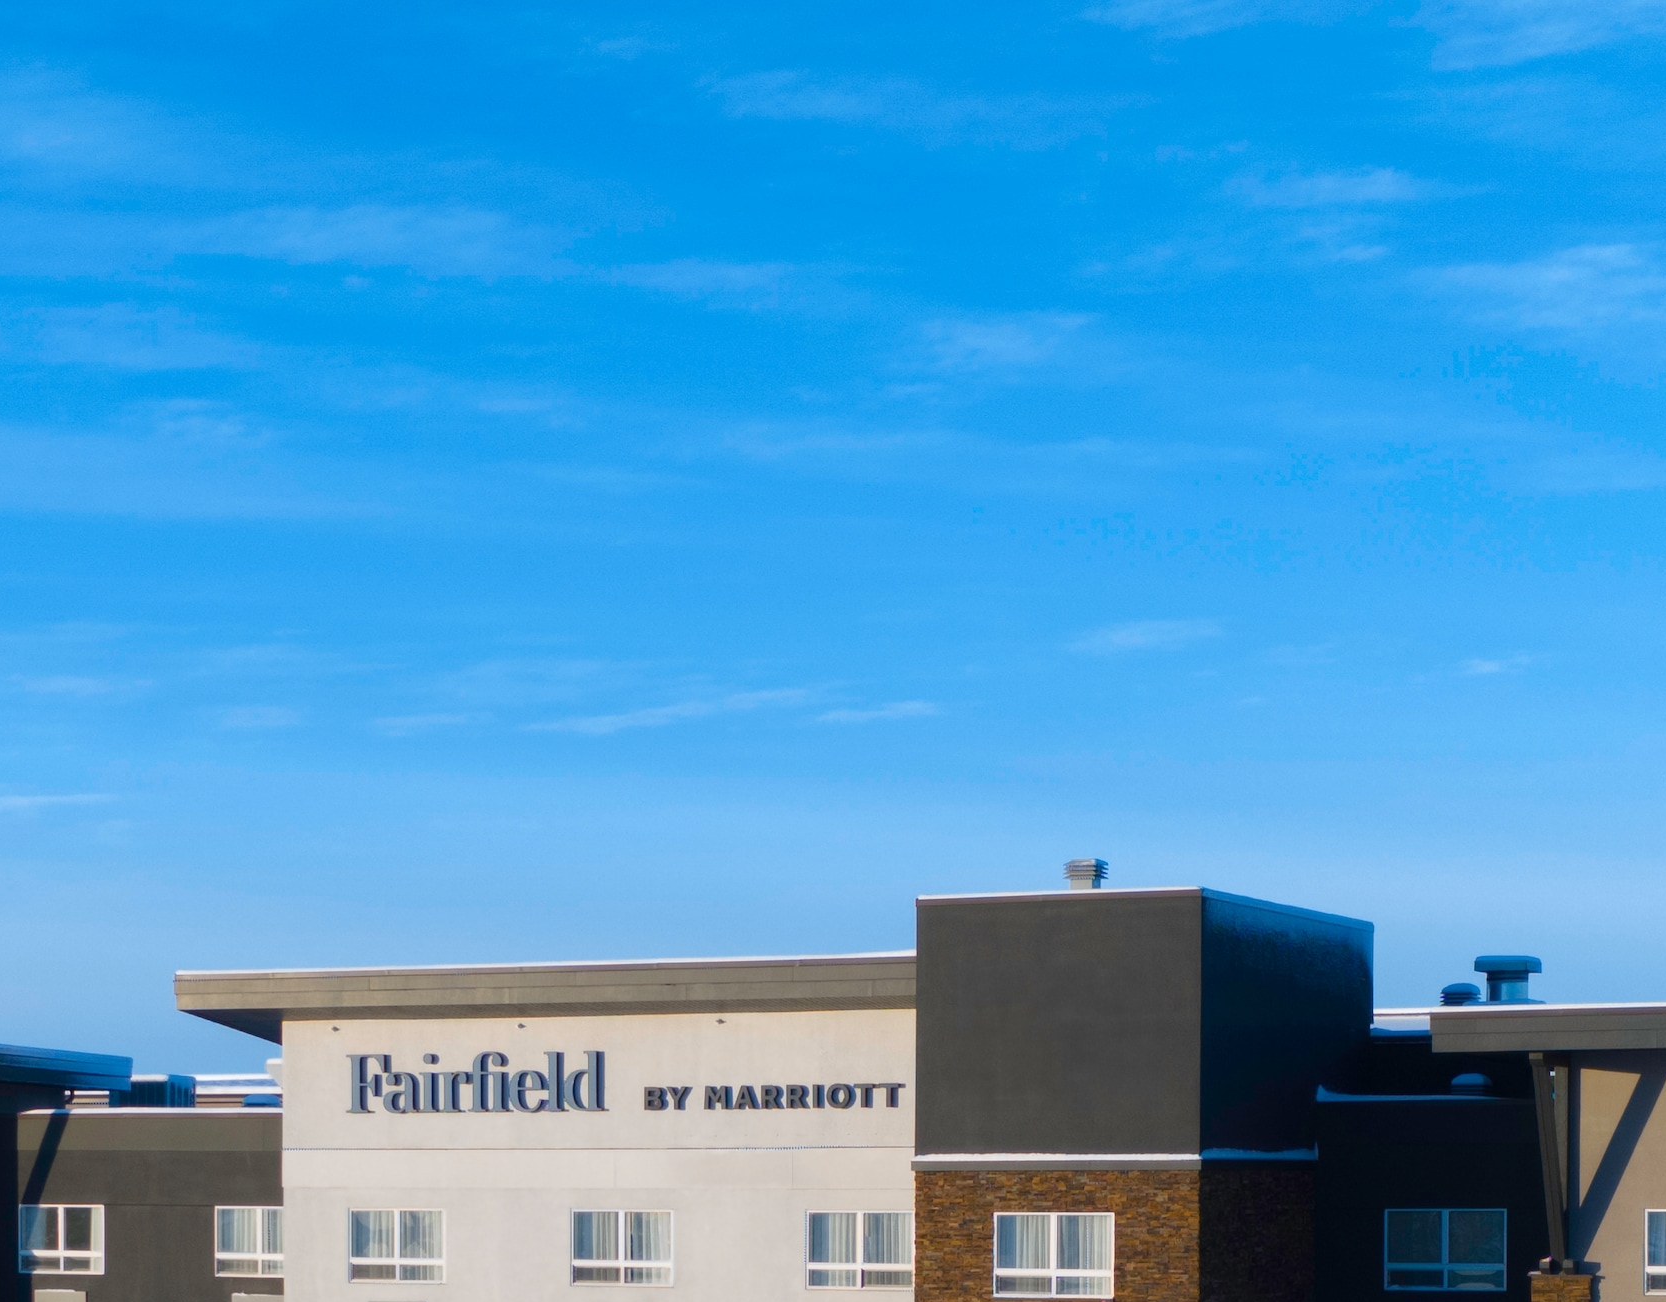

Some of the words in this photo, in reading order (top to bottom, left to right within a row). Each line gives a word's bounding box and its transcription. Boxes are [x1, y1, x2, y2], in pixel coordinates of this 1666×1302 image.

[346, 1051, 609, 1114] Fairfield
[644, 1086, 693, 1110] BY
[704, 1083, 906, 1110] MARRIOTT
